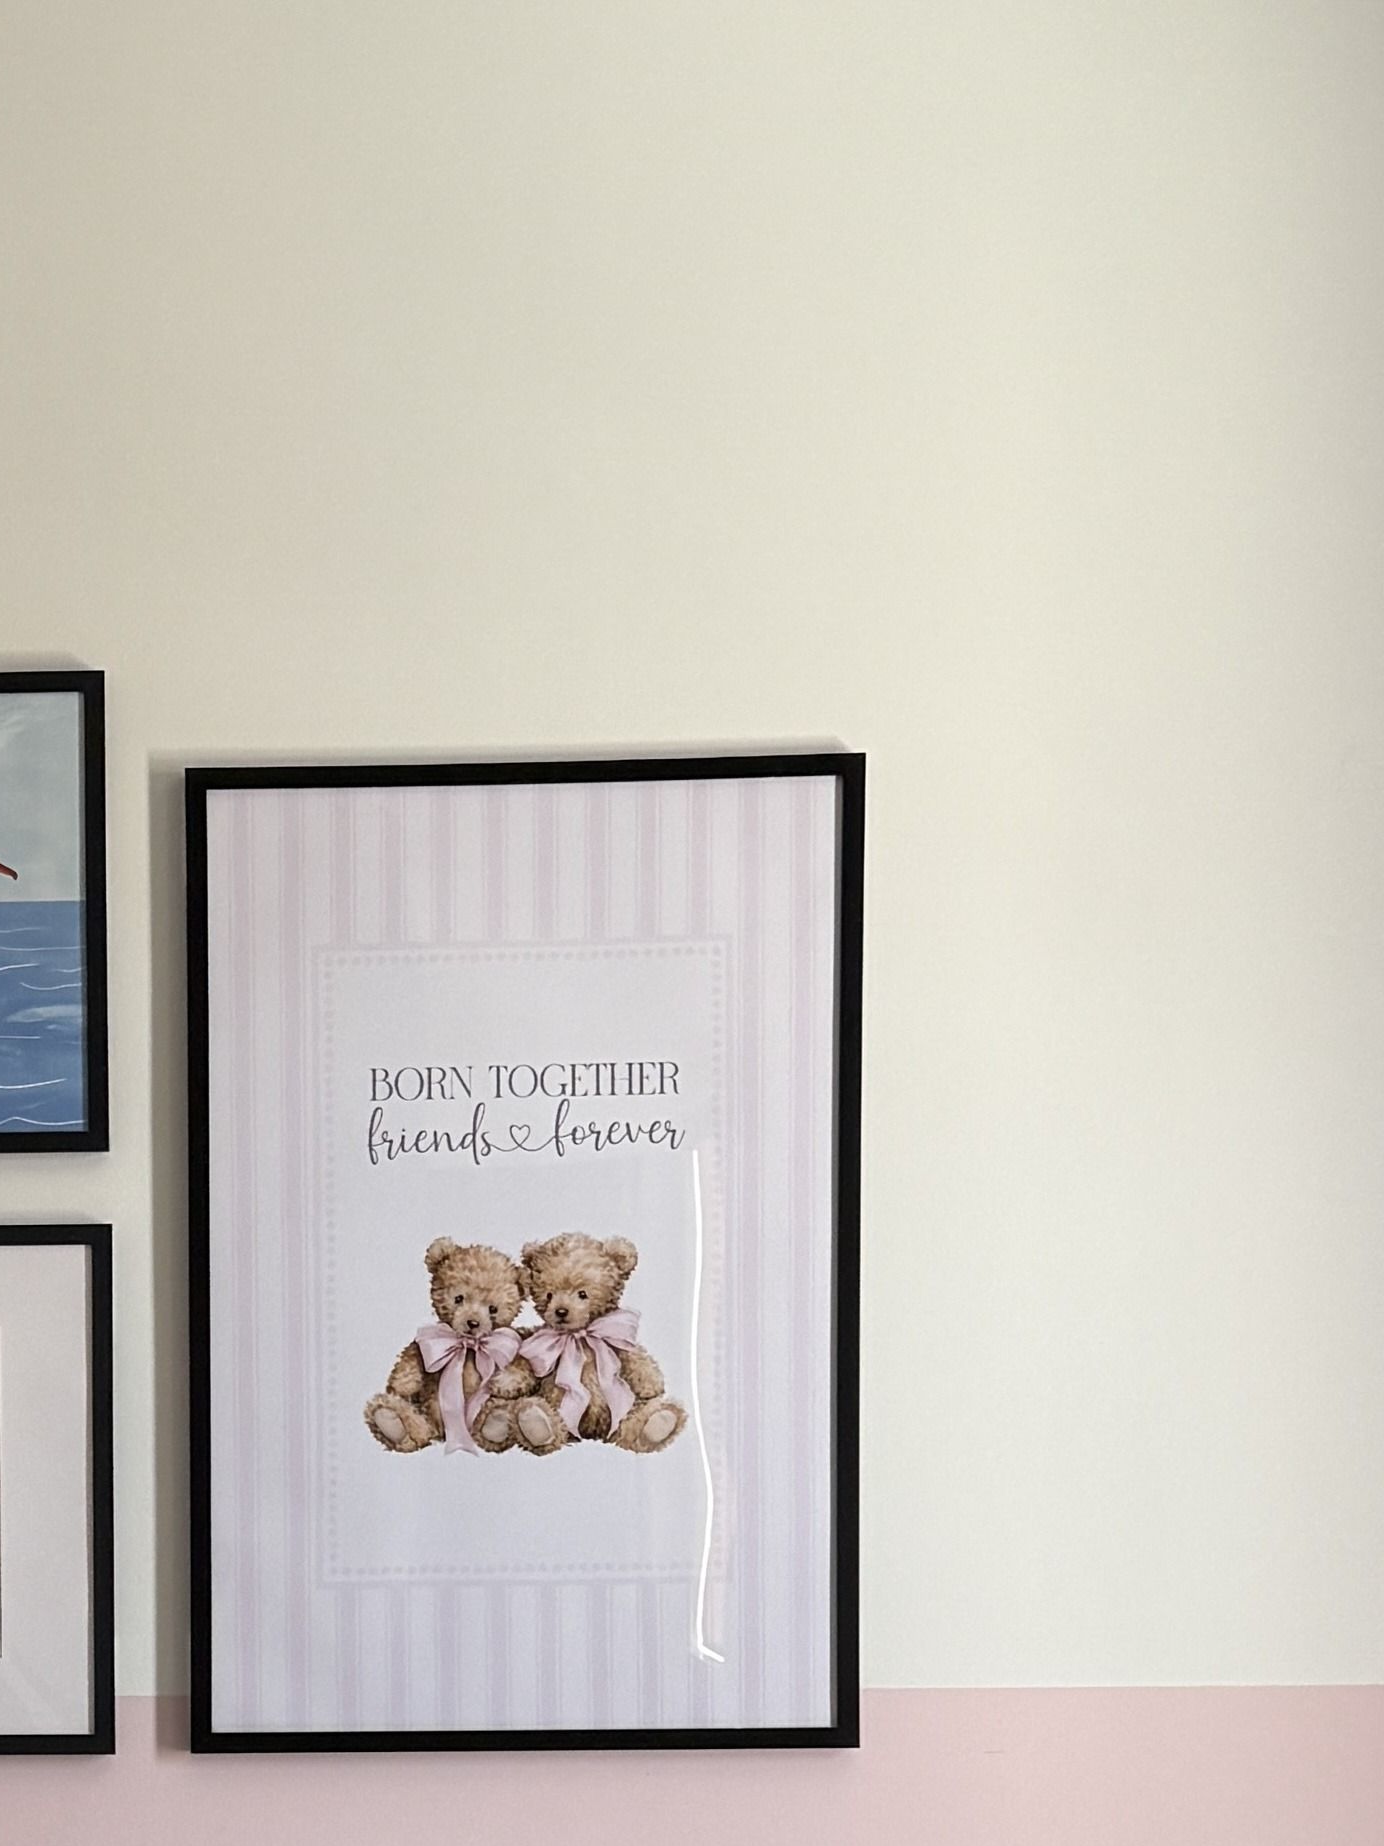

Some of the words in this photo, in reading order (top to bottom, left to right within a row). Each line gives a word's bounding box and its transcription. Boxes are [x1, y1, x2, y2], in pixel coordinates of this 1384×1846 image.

[369, 1065, 473, 1102] BORN
[488, 1061, 680, 1099] TOGETHER
[367, 1102, 495, 1166] friends
[551, 1098, 686, 1157] forever
